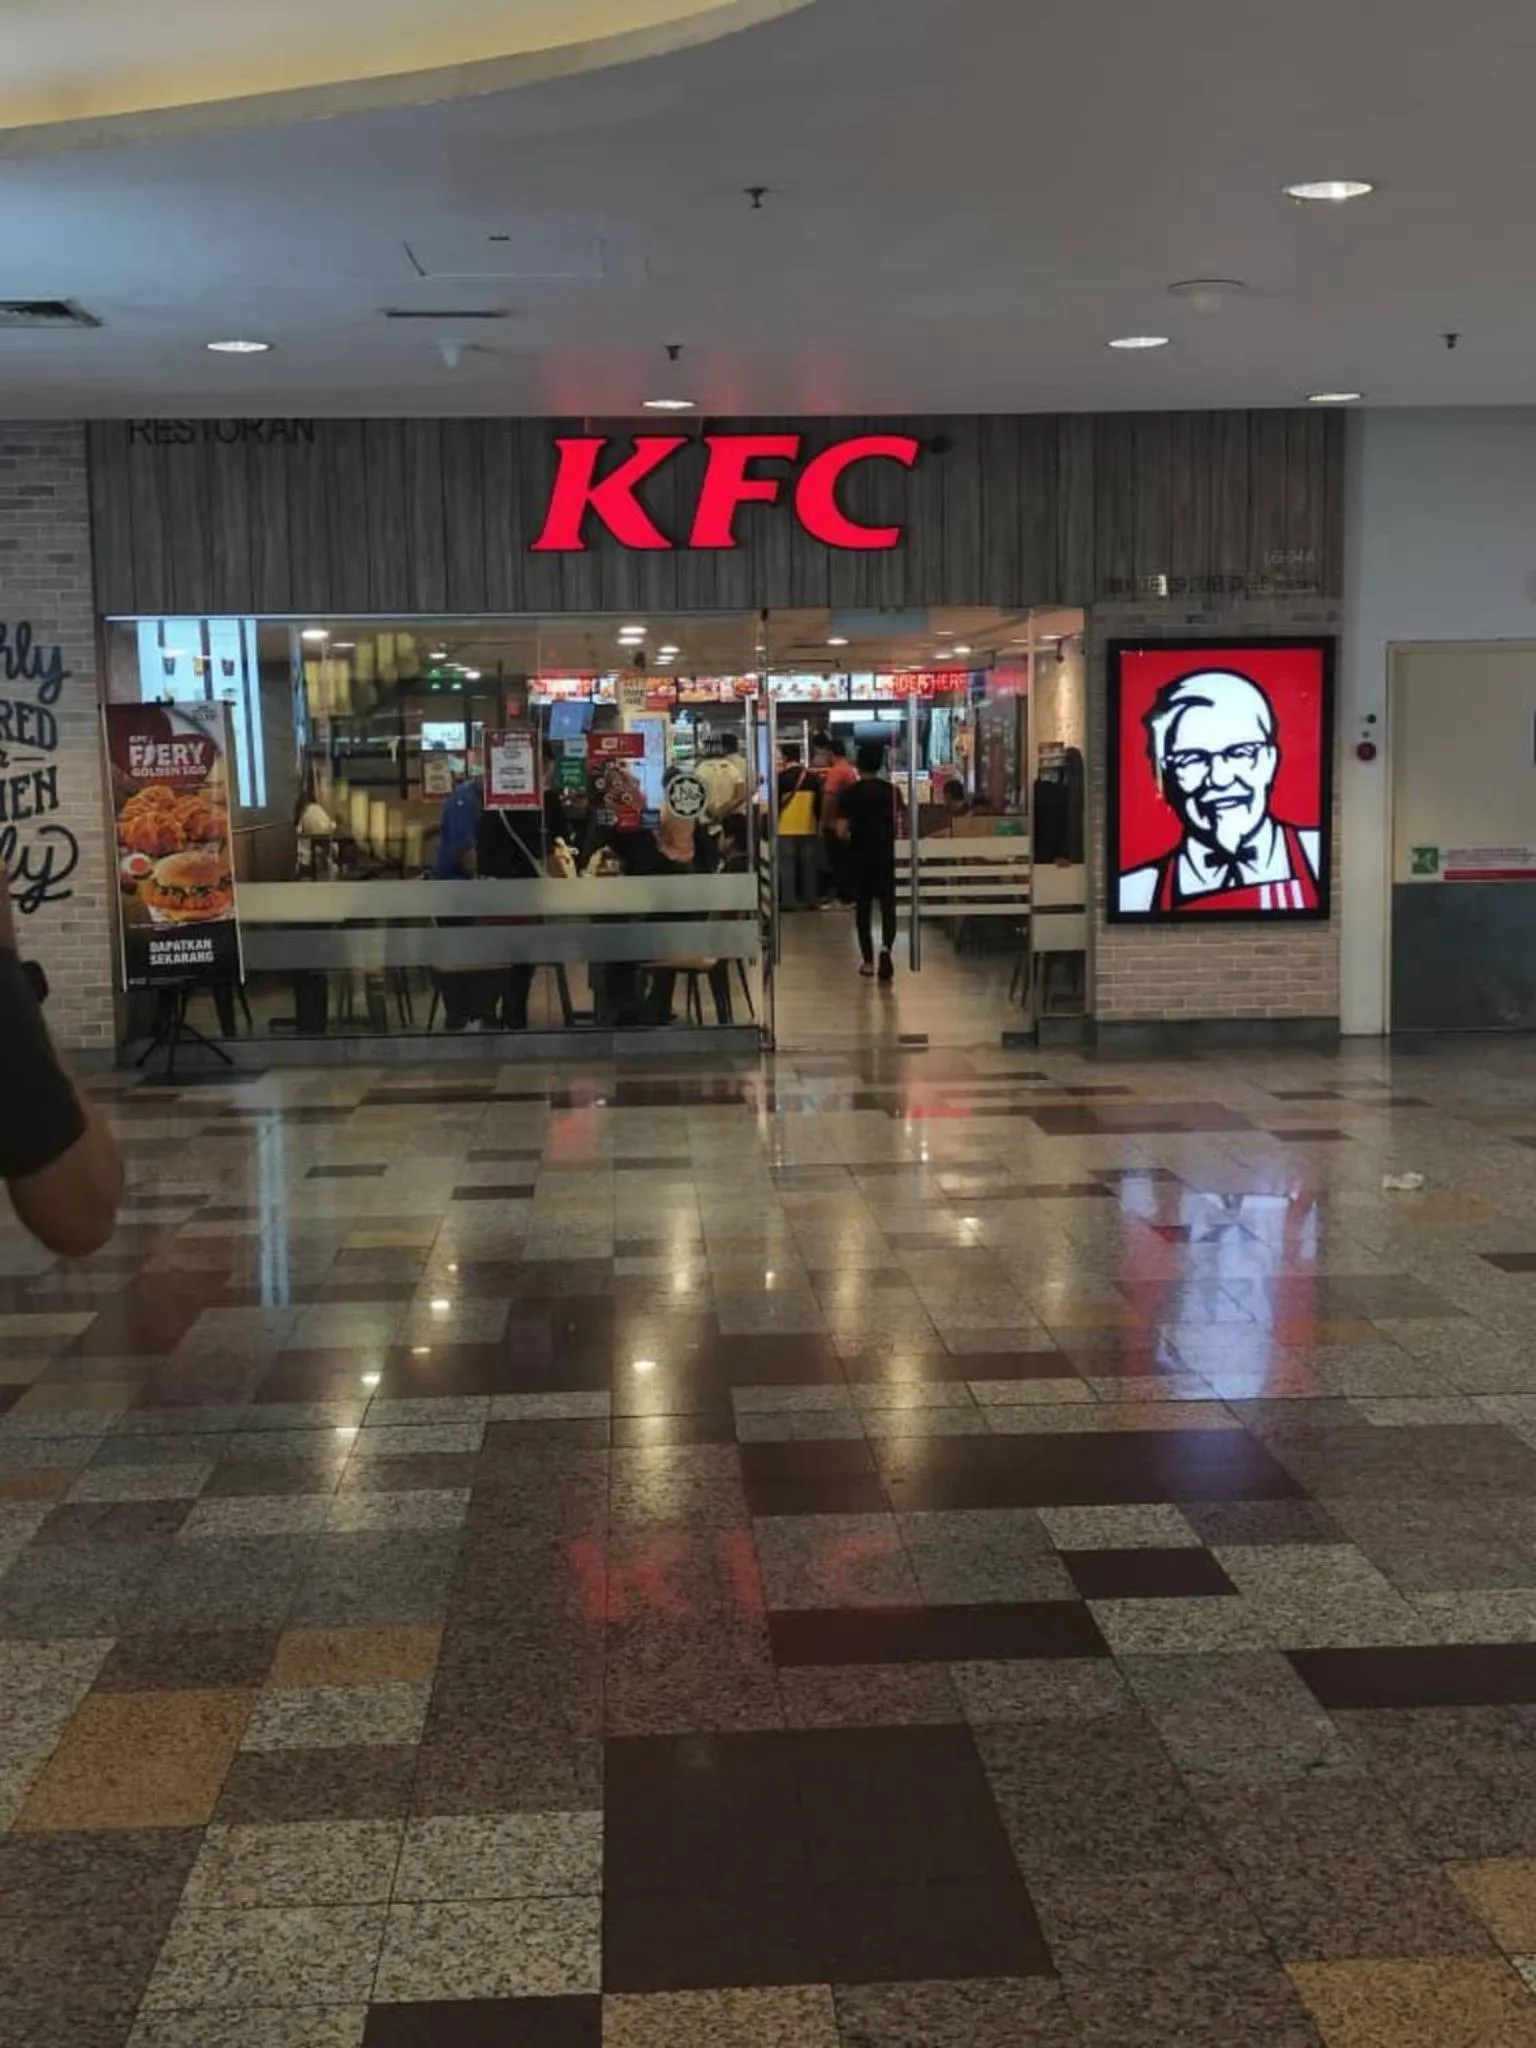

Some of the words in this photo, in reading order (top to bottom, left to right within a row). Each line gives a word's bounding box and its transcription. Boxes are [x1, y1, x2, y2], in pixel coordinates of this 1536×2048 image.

[125, 417, 315, 445] RESTORAN
[528, 434, 921, 552] KFC
[149, 939, 212, 953] DAPATKAN
[149, 951, 215, 966] SEKARANG
